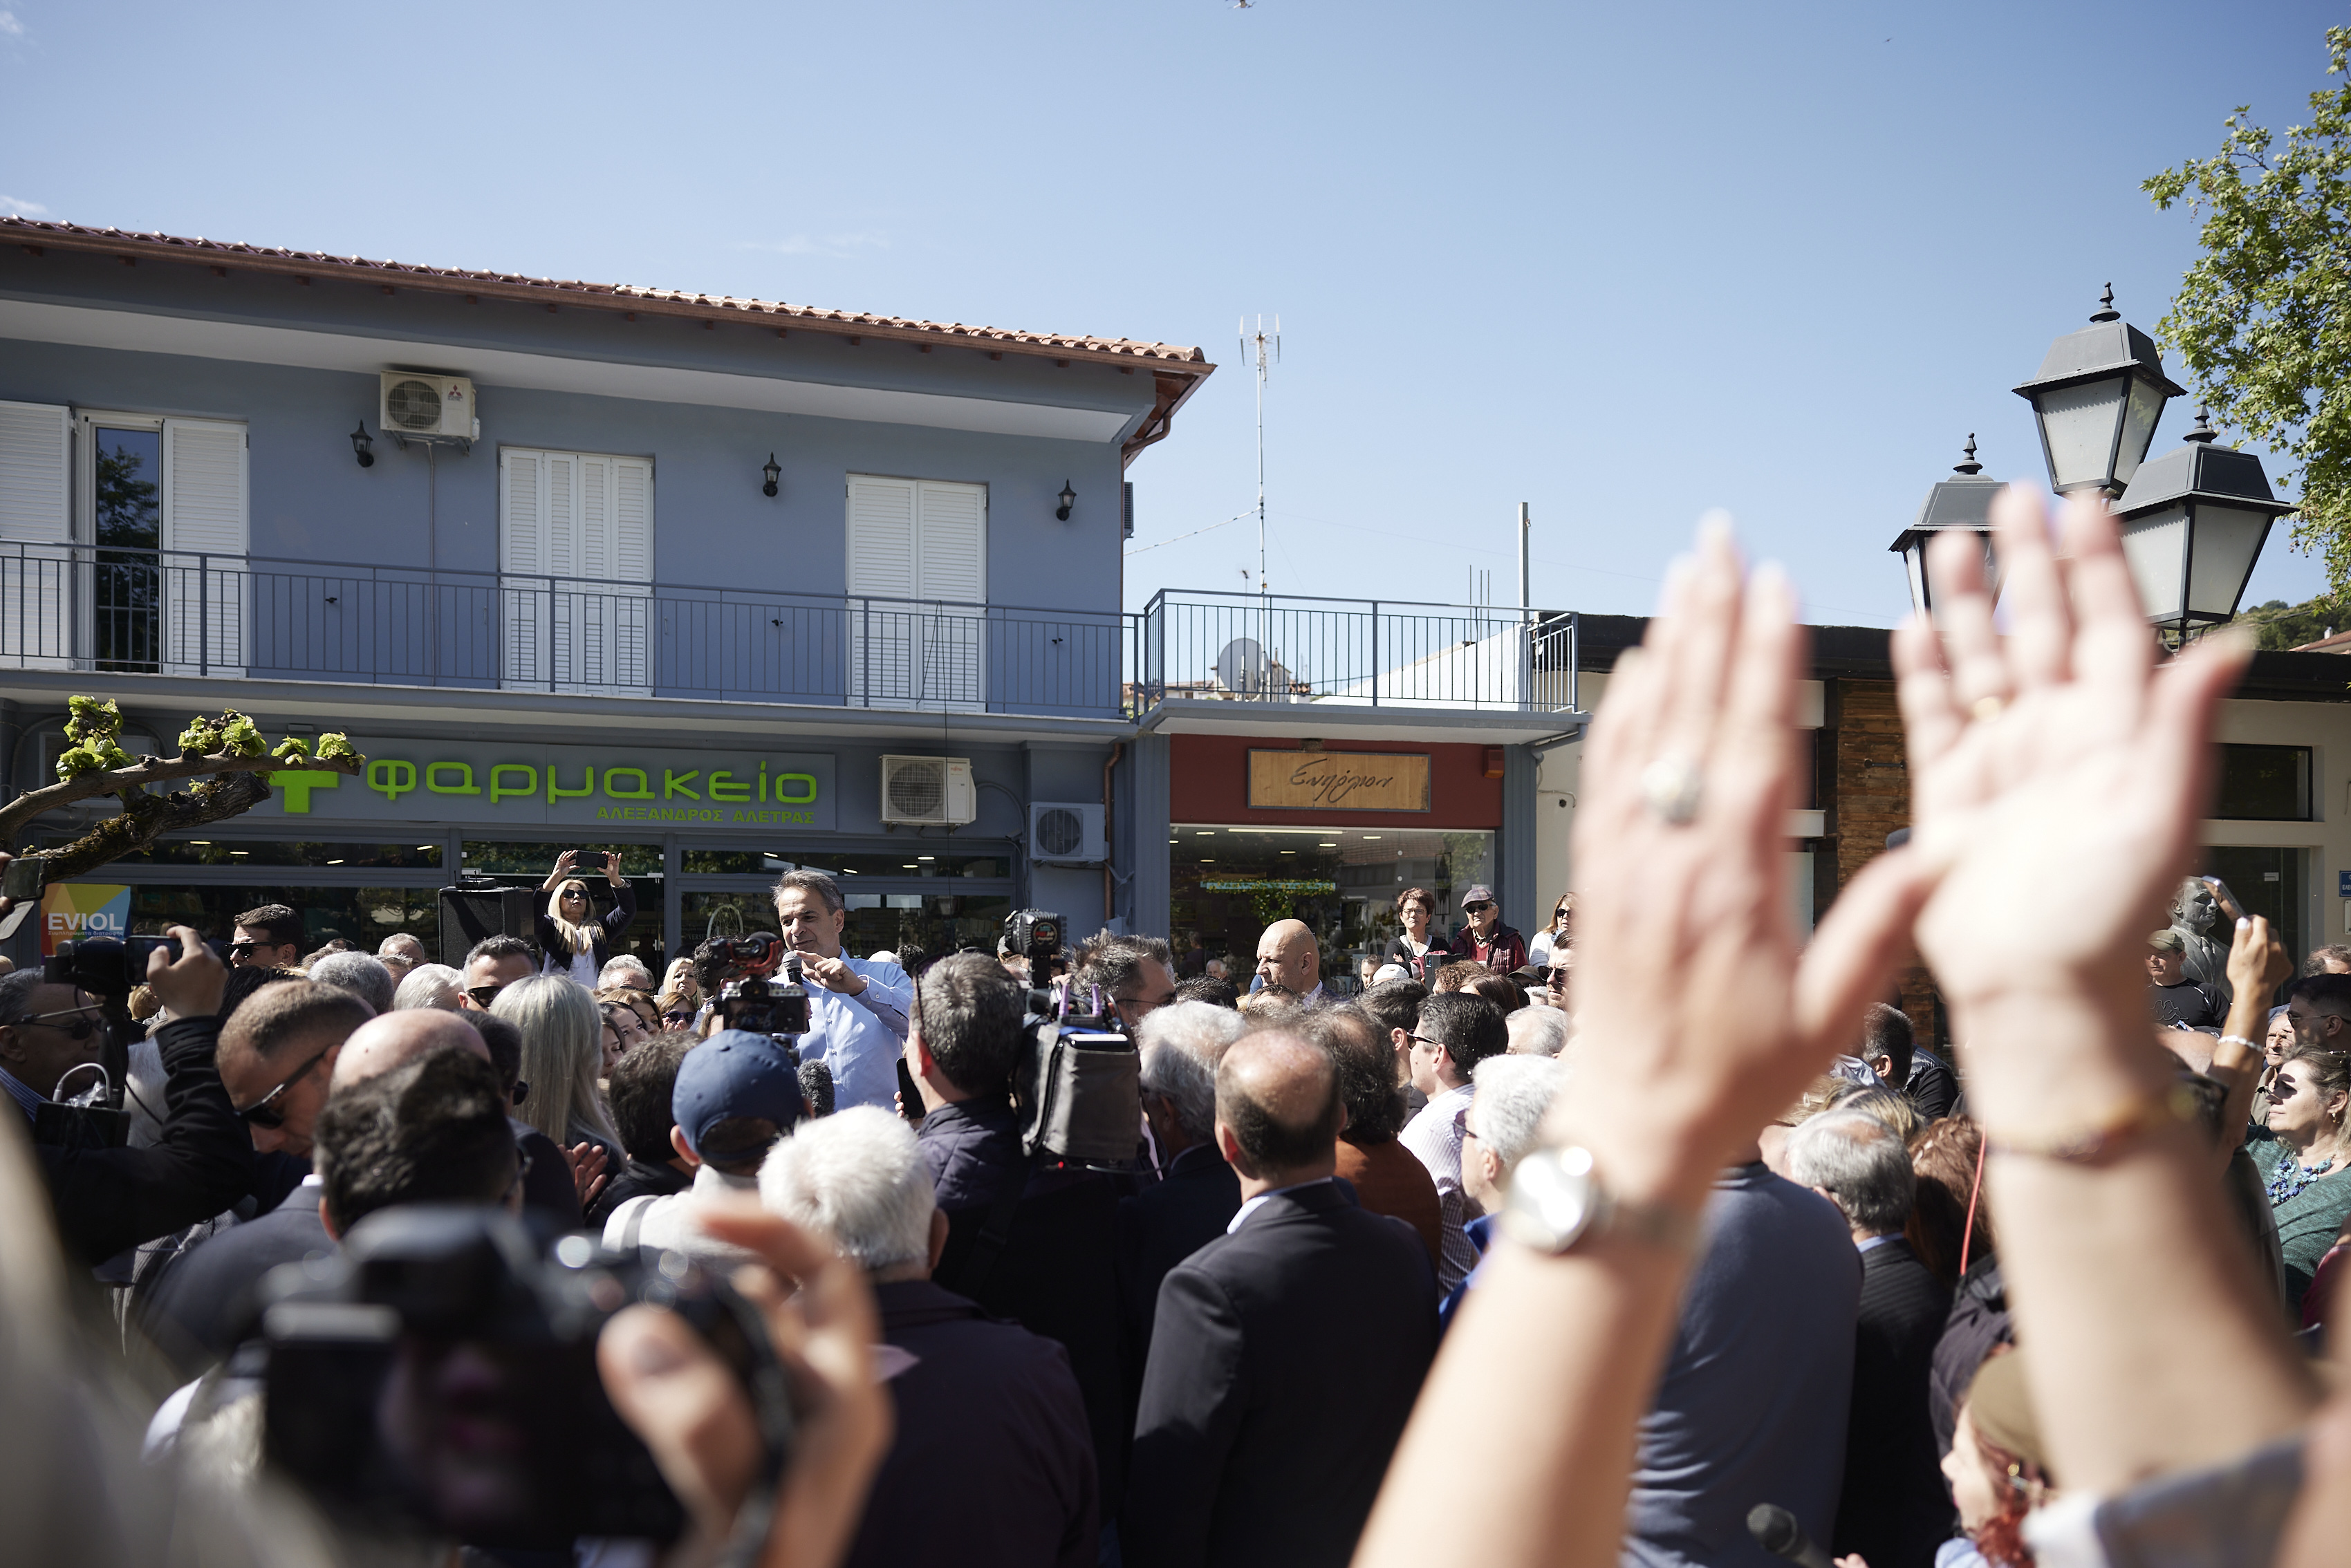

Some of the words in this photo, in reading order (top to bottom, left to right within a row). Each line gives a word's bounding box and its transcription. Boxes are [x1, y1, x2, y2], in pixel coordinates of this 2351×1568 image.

[366, 759, 817, 805] φαρμακείο
[596, 806, 723, 822] ΑΛΕΞΑΝΔΡΟΣ
[732, 810, 815, 824] ΑΛΕΤΡΑΣ
[48, 913, 123, 931] EVIOL
